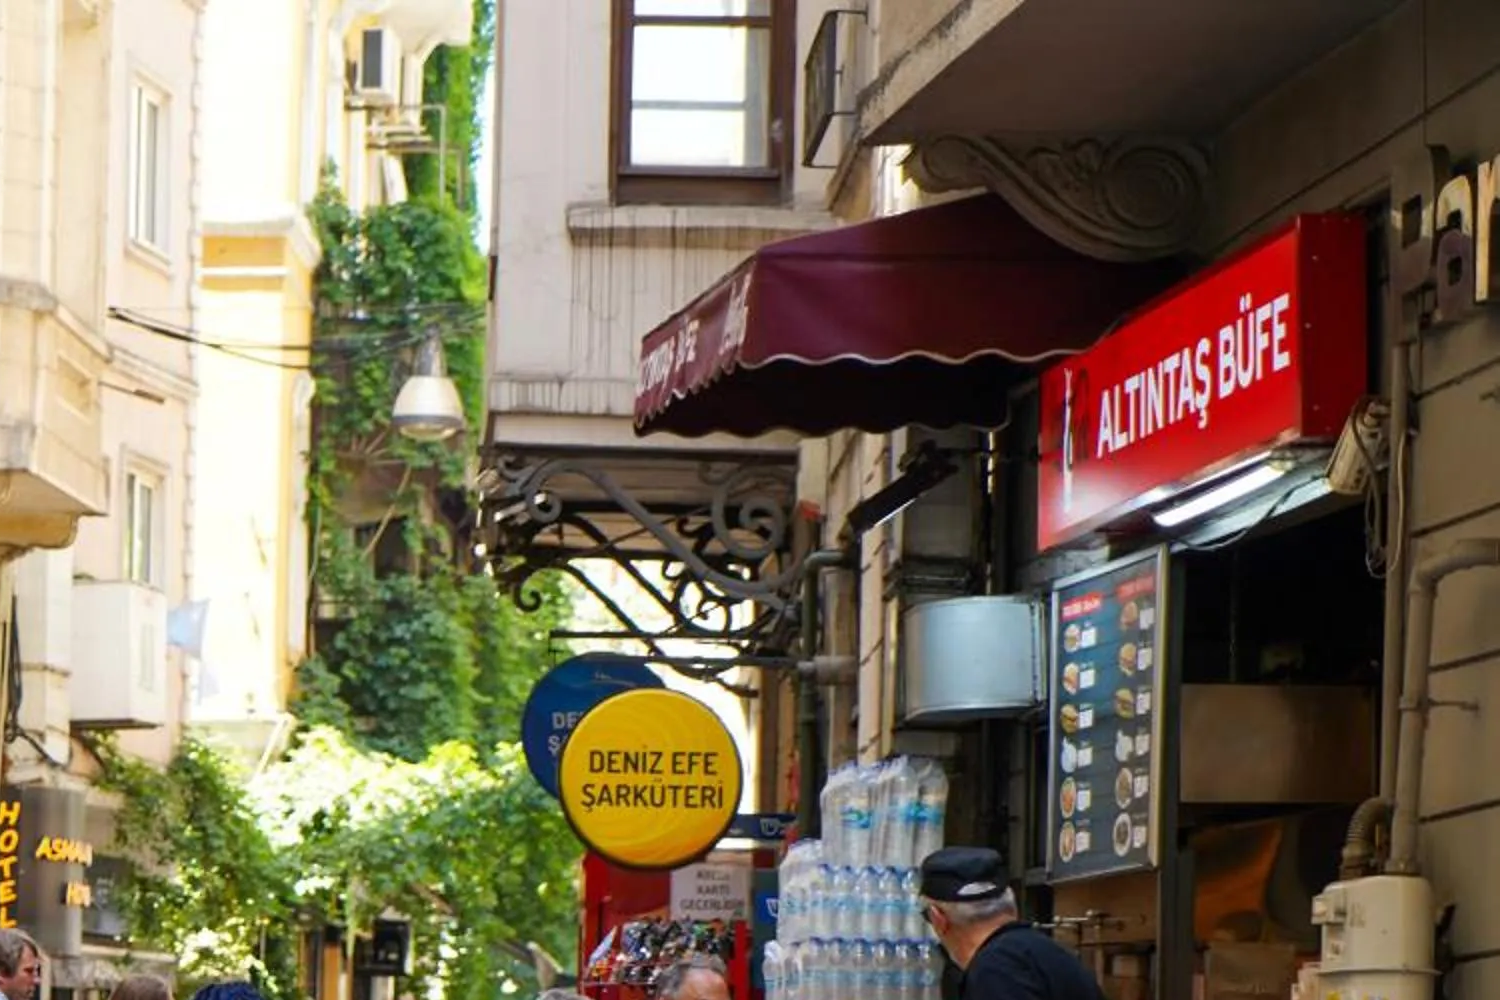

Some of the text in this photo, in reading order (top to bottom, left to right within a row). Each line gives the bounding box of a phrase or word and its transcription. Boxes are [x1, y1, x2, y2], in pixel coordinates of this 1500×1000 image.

[1097, 293, 1291, 459] ALTINTAŞ BÜFE
[588, 744, 664, 775] DENİZ
[670, 751, 720, 776] EFE
[581, 777, 724, 813] ŞARKÜTERİ
